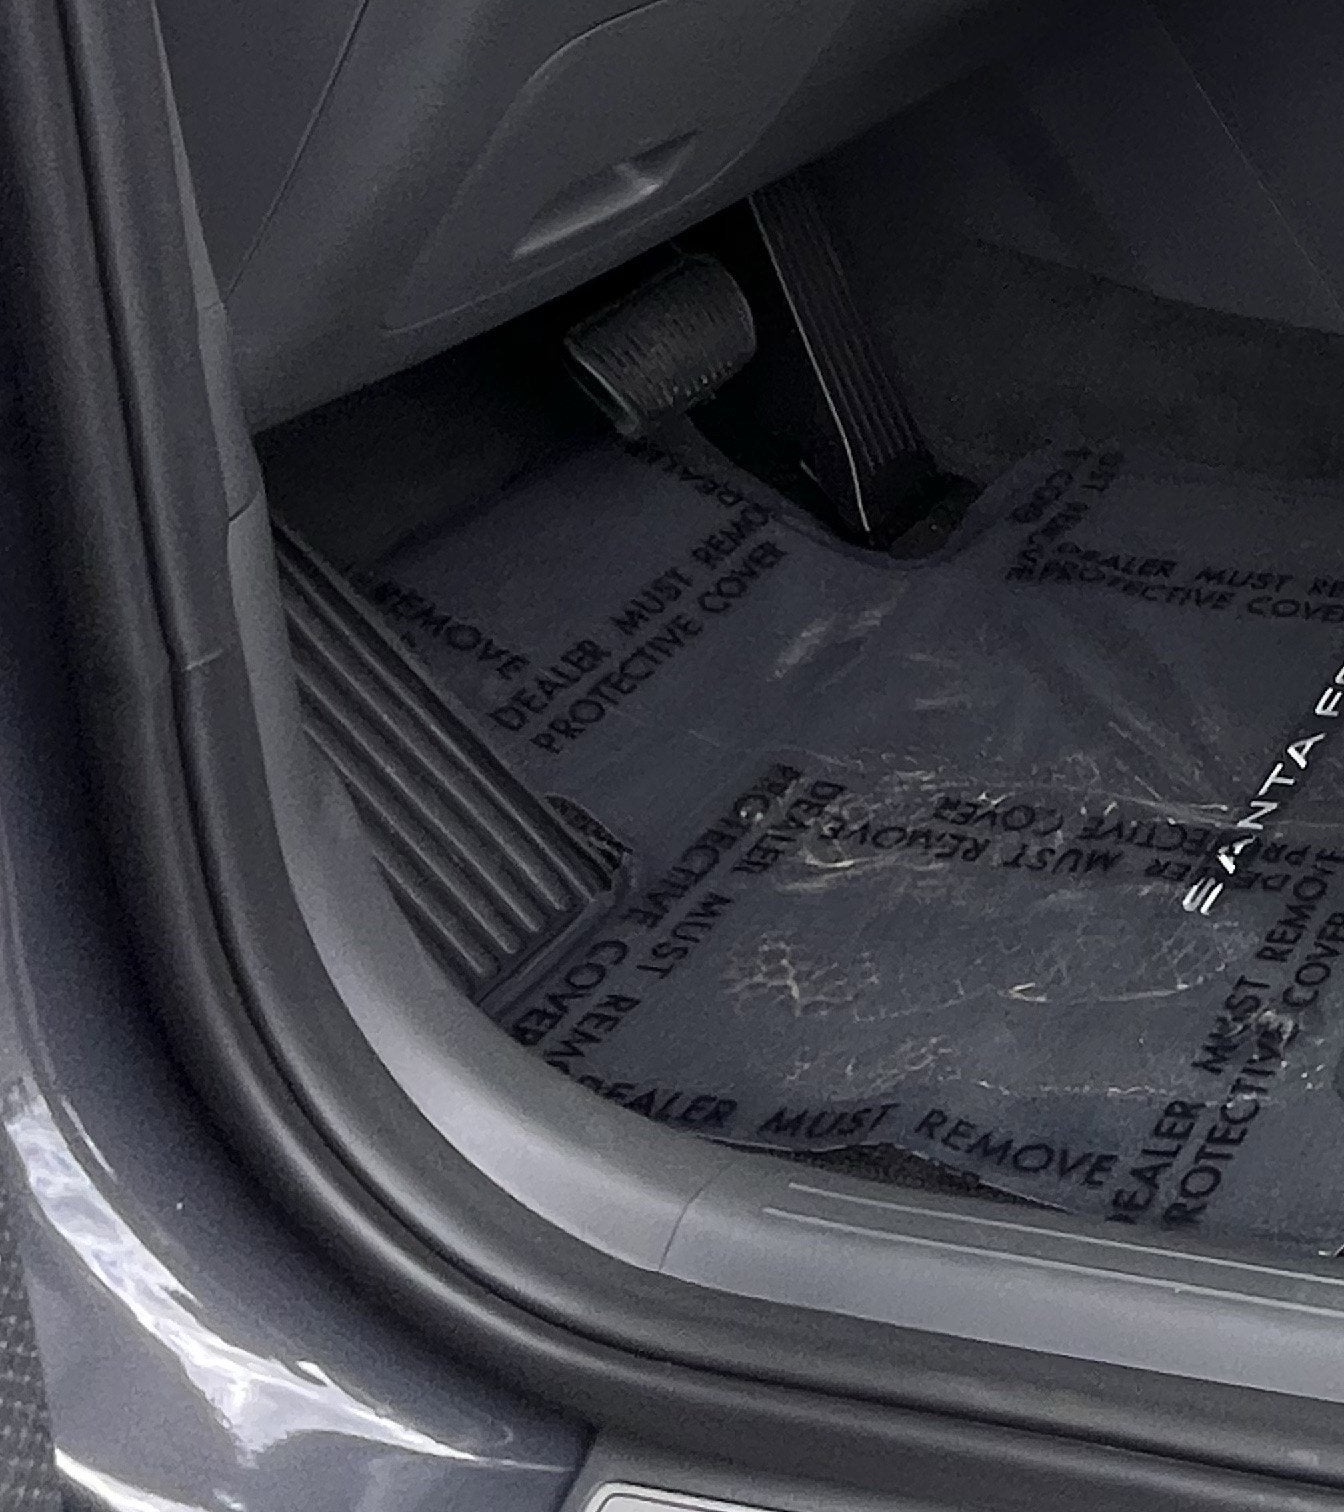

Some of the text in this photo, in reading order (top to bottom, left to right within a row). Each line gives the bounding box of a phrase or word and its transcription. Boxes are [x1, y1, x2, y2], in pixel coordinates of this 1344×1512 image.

[1037, 560, 1236, 613] PROTECTIVE
[1194, 566, 1294, 592] MUST
[488, 637, 612, 735] DEALER
[609, 566, 695, 638] MUST
[530, 617, 704, 755] PROTECTIVE
[699, 542, 788, 618] COVER
[933, 795, 1065, 832] COVER
[1005, 838, 1123, 875] MUST
[1182, 731, 1327, 916] SANTA
[637, 891, 735, 980] MUST
[510, 940, 629, 1047] COVER
[759, 1103, 903, 1141] MUST
[914, 1108, 1118, 1187] REMOVE
[1161, 1011, 1299, 1228] ROTECTIVE
